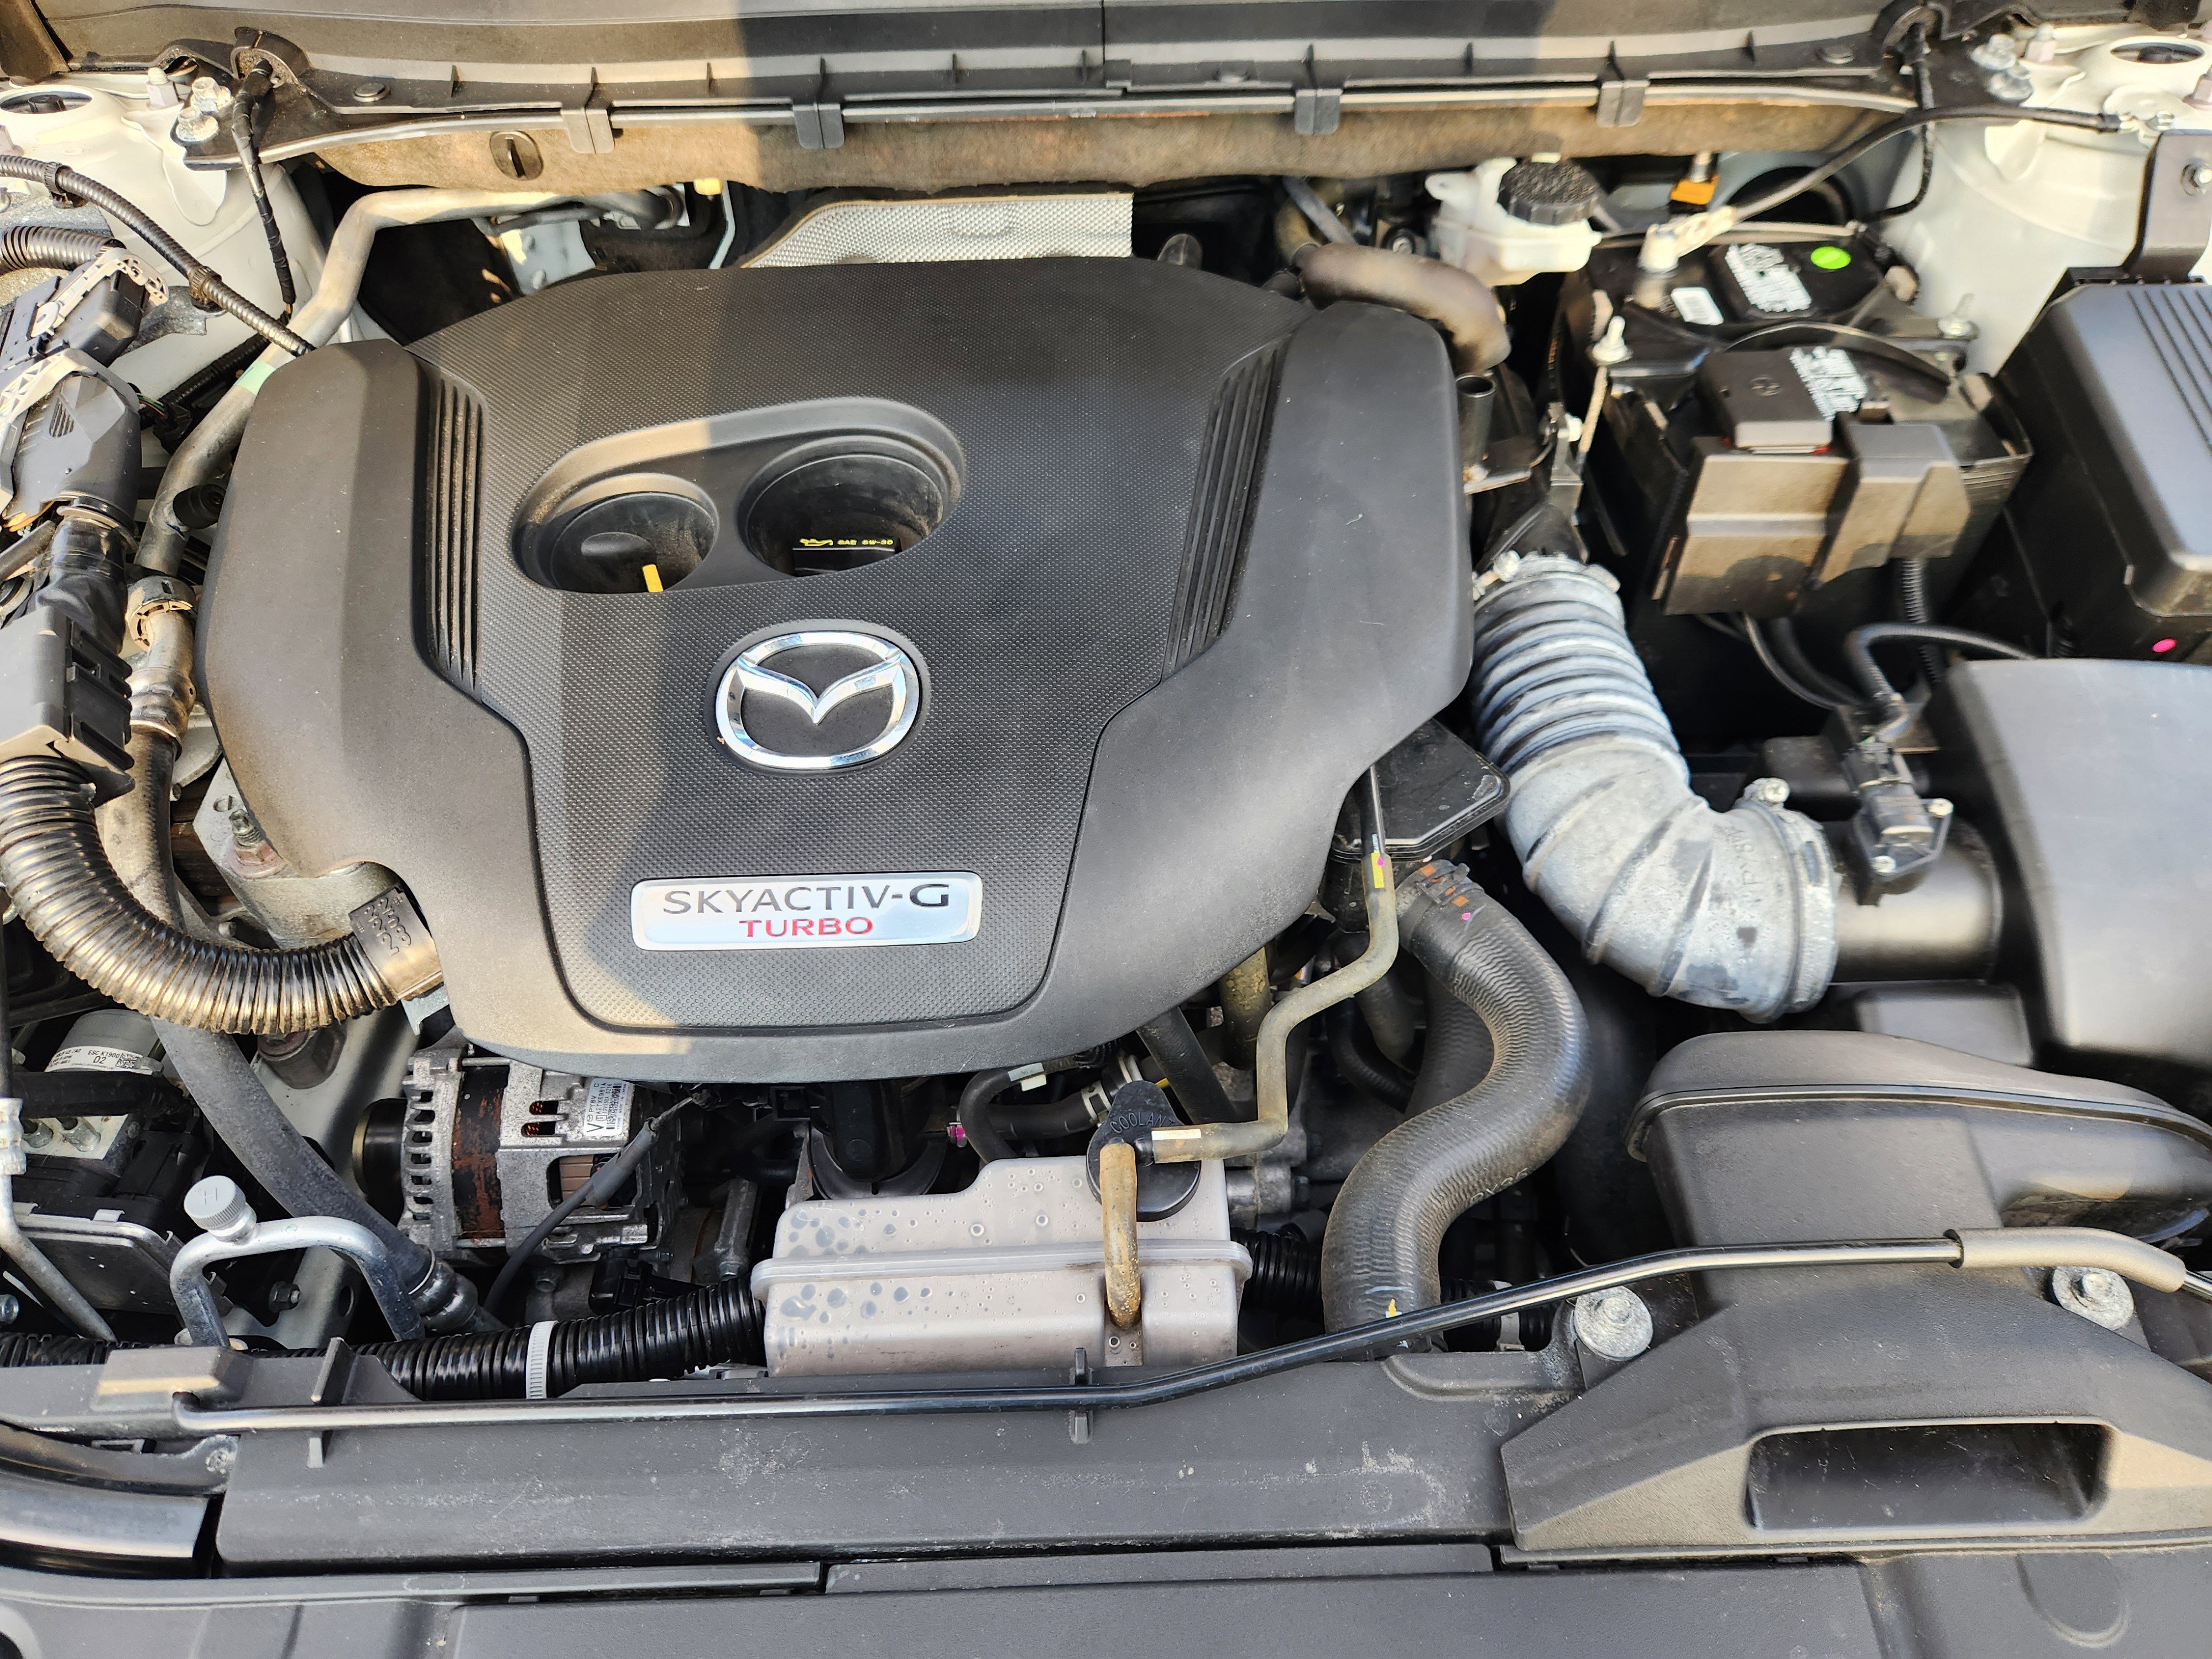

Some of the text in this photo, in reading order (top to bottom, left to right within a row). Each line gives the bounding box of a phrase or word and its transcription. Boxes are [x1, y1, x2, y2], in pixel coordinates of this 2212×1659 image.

[662, 883, 950, 914] SKYACTIV-G
[739, 916, 874, 938] TURBO
[1109, 1111, 1176, 1134] COOLANT
[204, 1187, 218, 1205] H
